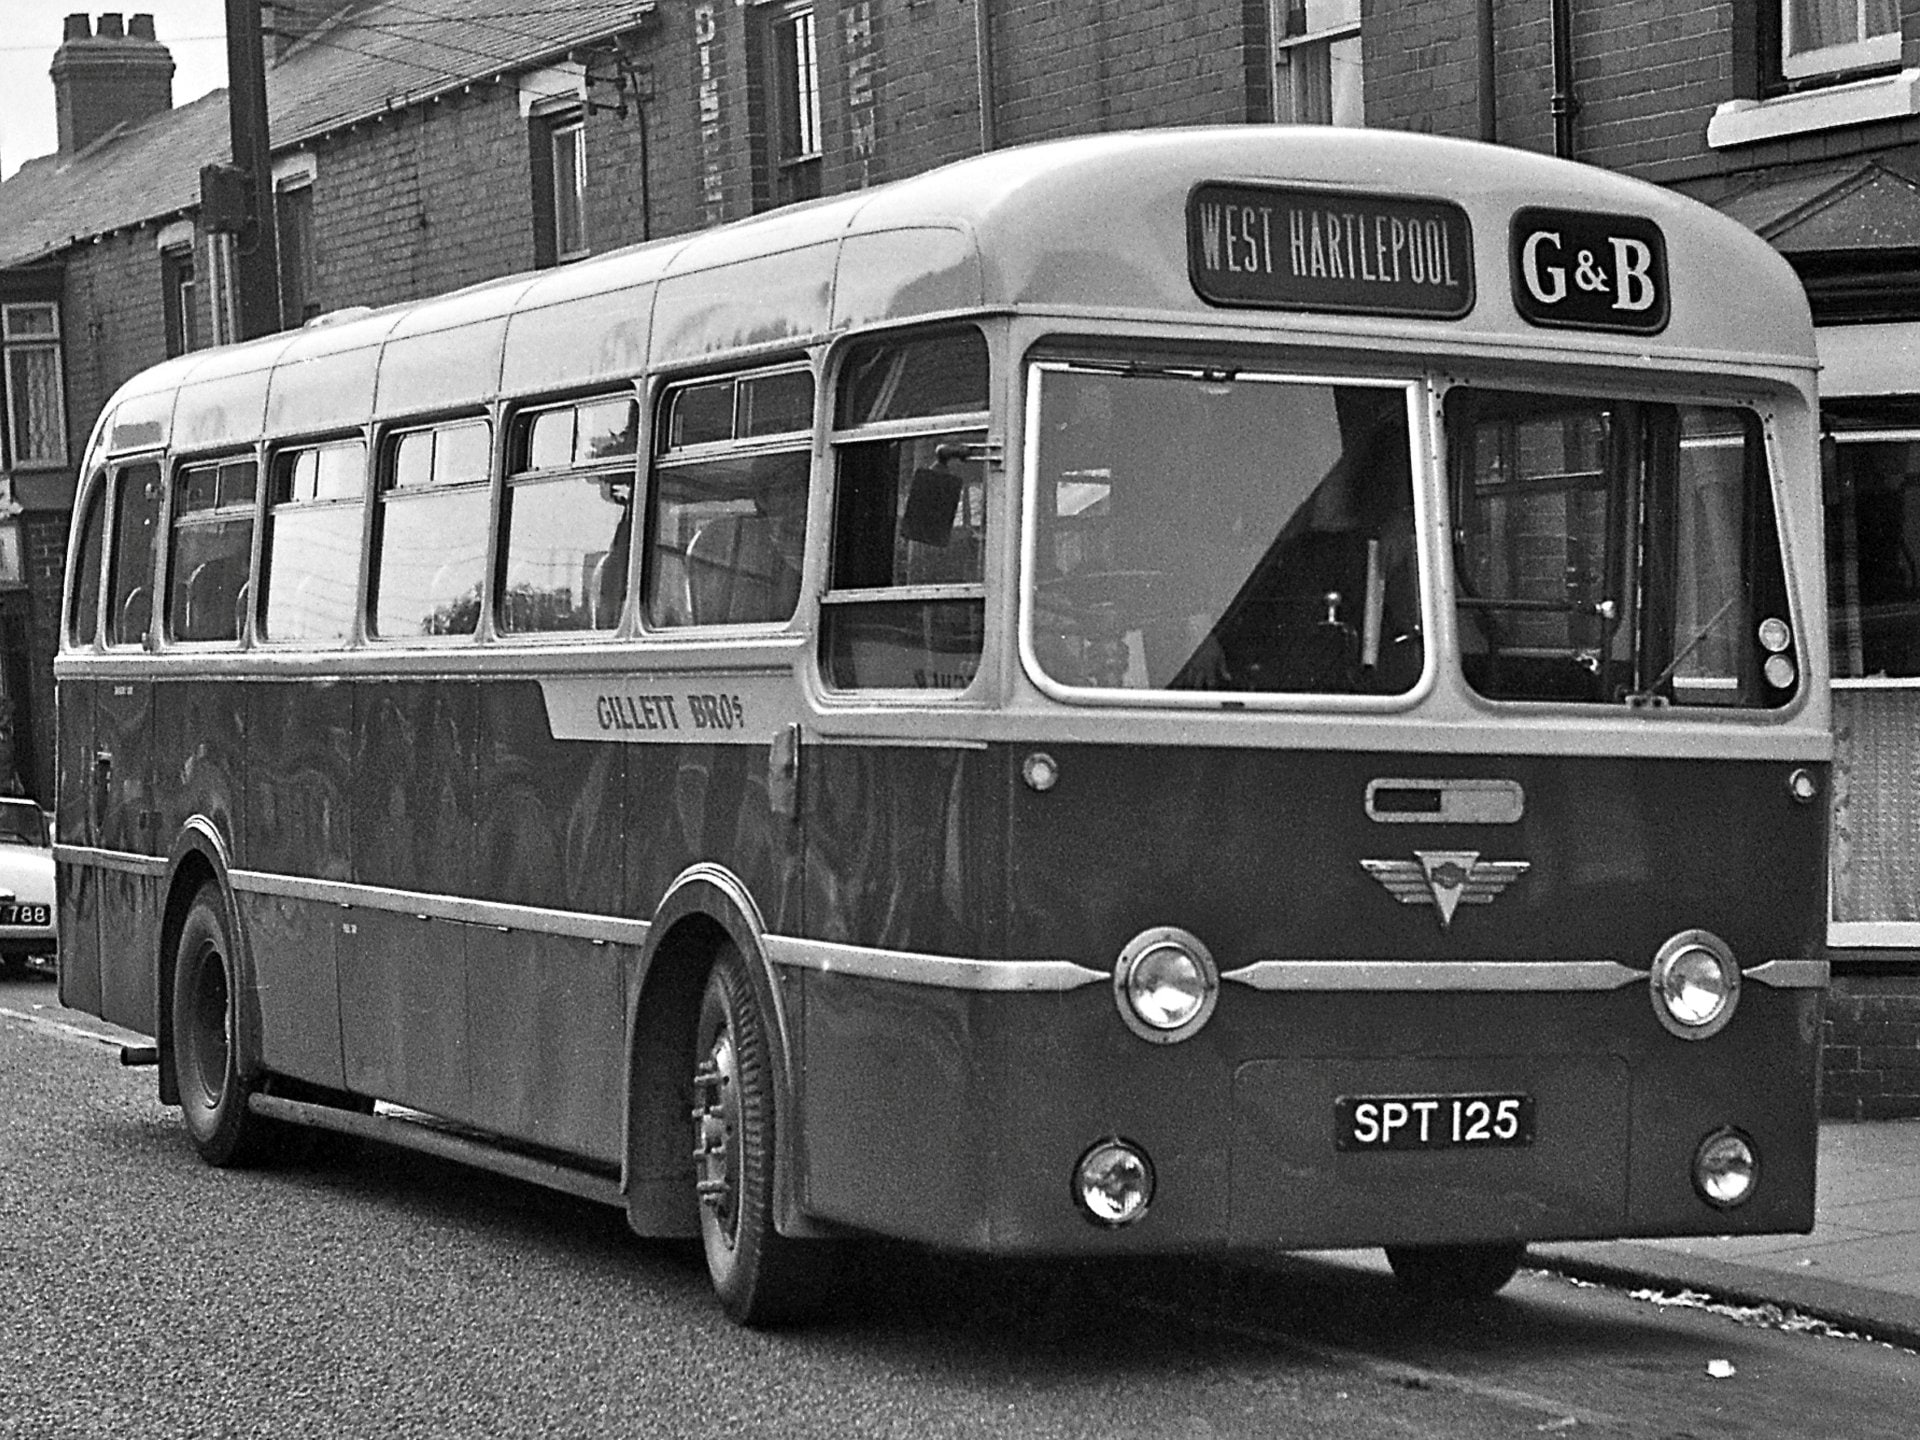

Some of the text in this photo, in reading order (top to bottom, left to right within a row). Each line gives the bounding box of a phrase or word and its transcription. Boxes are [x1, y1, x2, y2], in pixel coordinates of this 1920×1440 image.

[1200, 203, 1459, 286] WEST HARTLEPOOL
[597, 695, 679, 730] GILLETT
[9, 905, 46, 923] 788
[1354, 1099, 1520, 1143] SPT 125
